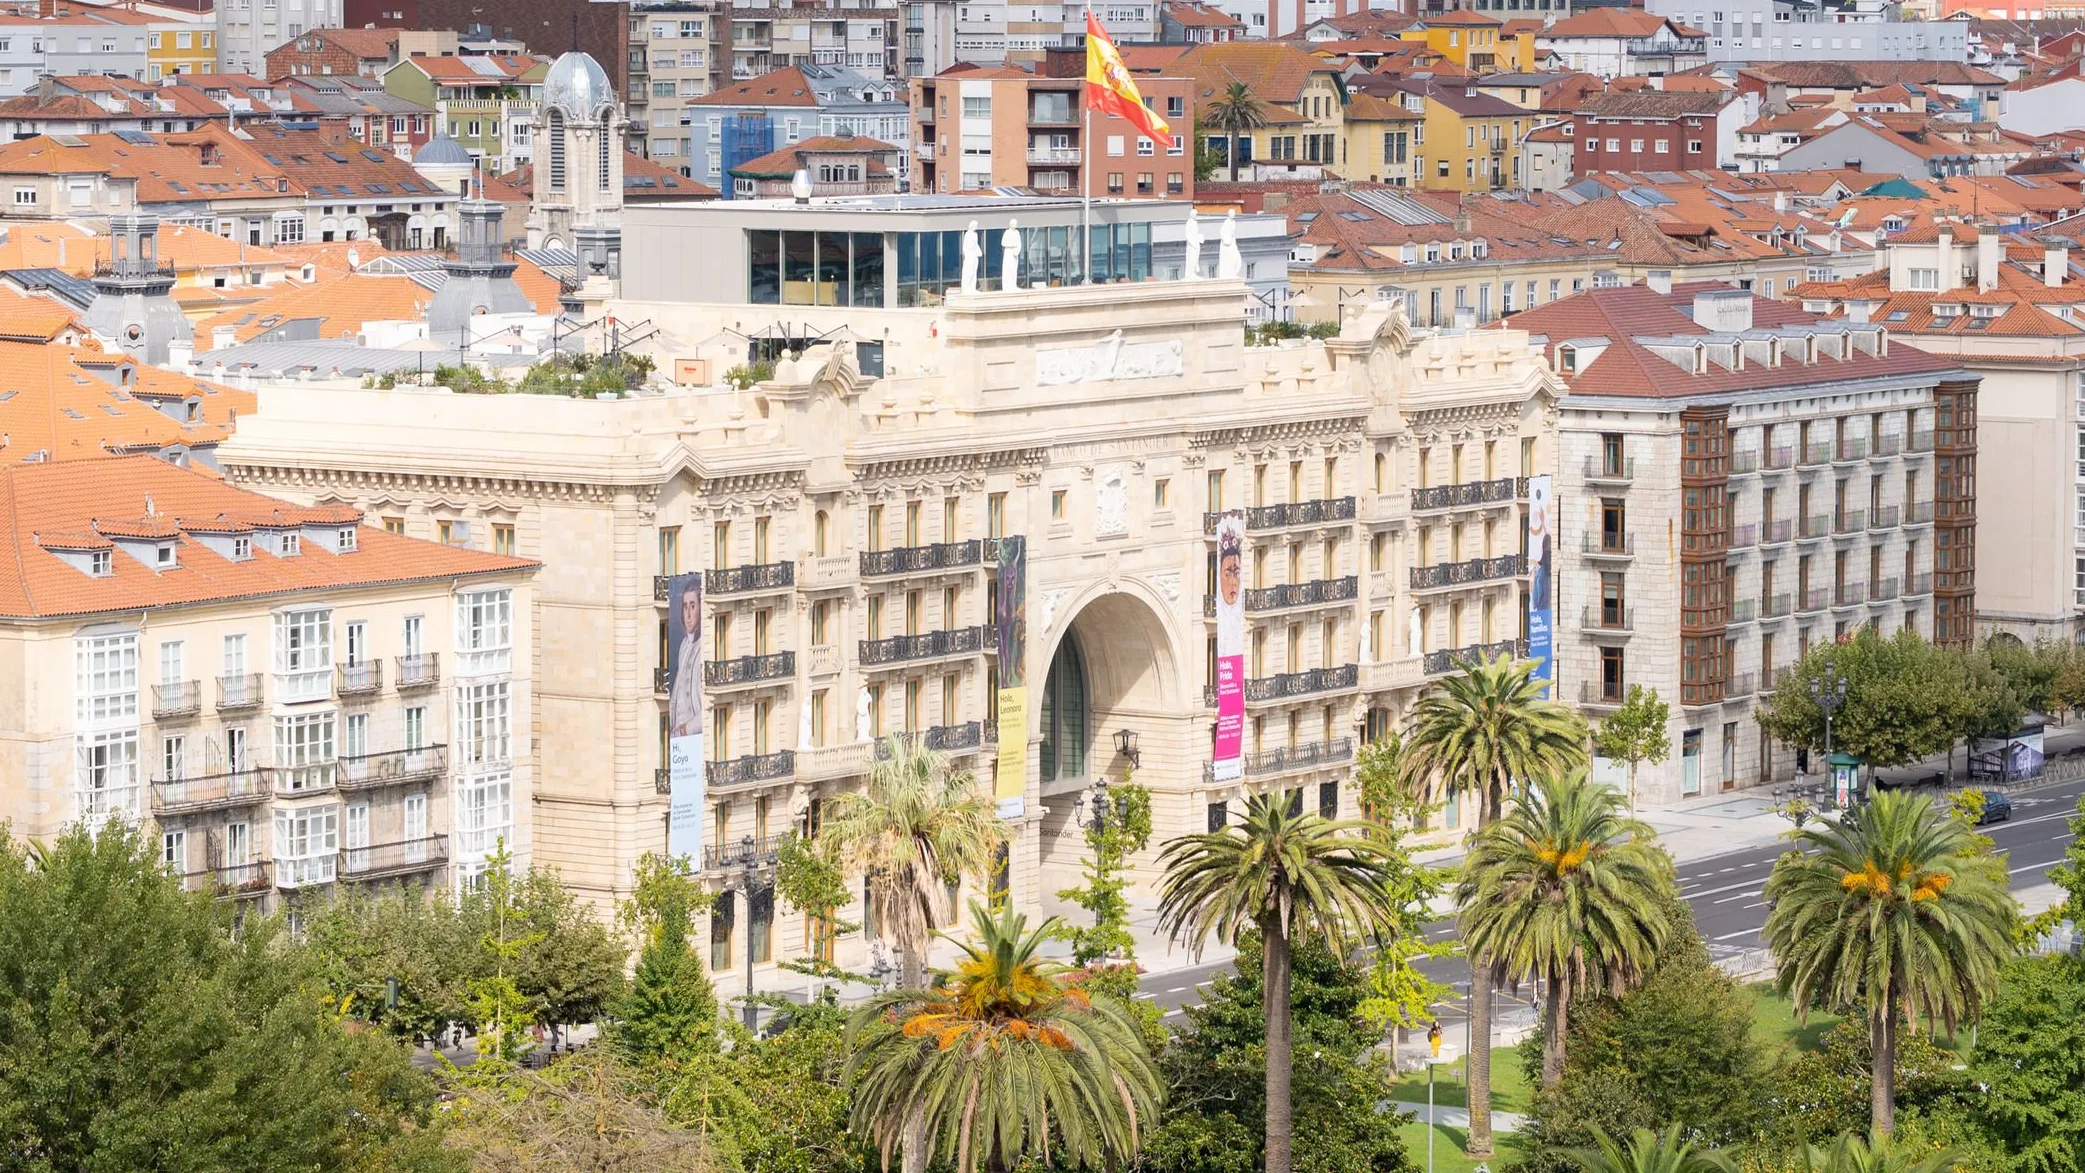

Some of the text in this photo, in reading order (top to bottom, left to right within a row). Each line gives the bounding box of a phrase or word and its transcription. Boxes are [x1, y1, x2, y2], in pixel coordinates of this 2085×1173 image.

[1220, 671, 1233, 681] Frida
[1000, 694, 1014, 704] Hola,
[1000, 705, 1021, 714] Leonora
[672, 743, 681, 753] Hi,
